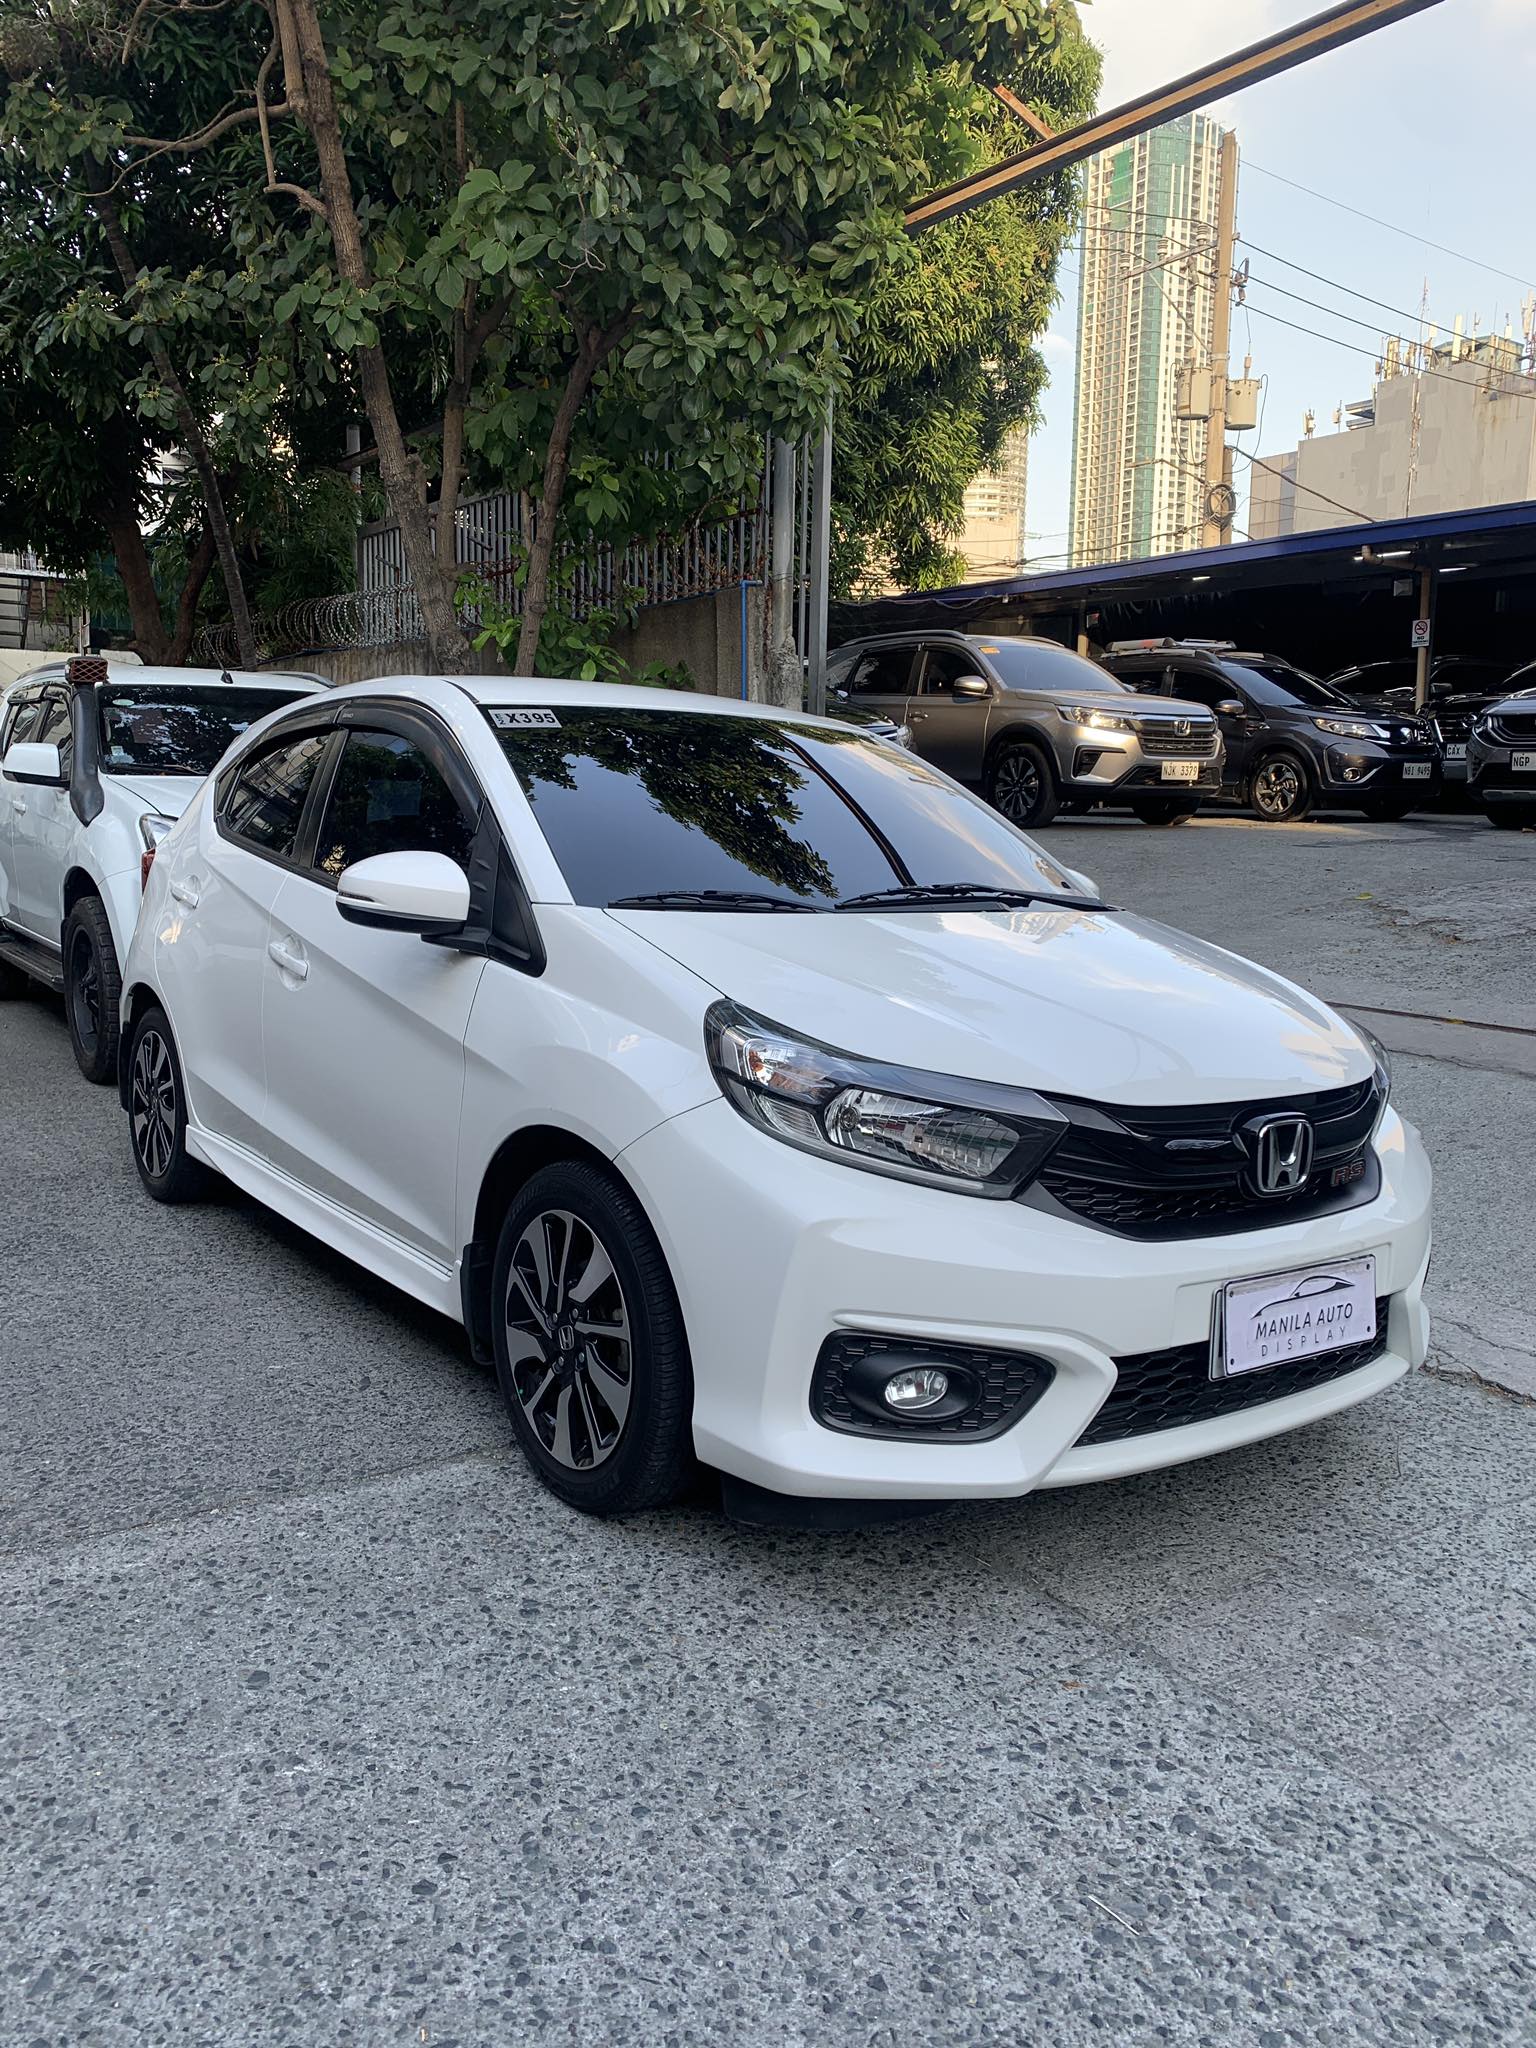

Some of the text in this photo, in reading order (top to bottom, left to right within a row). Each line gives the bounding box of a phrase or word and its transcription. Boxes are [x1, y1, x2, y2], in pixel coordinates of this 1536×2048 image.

[505, 712, 556, 725] X395
[1513, 756, 1530, 767] NGP
[1163, 765, 1198, 777] NJK 3379
[1256, 1302, 1354, 1340] MANILA AUTO
[1261, 1326, 1347, 1357] DISPLAY
